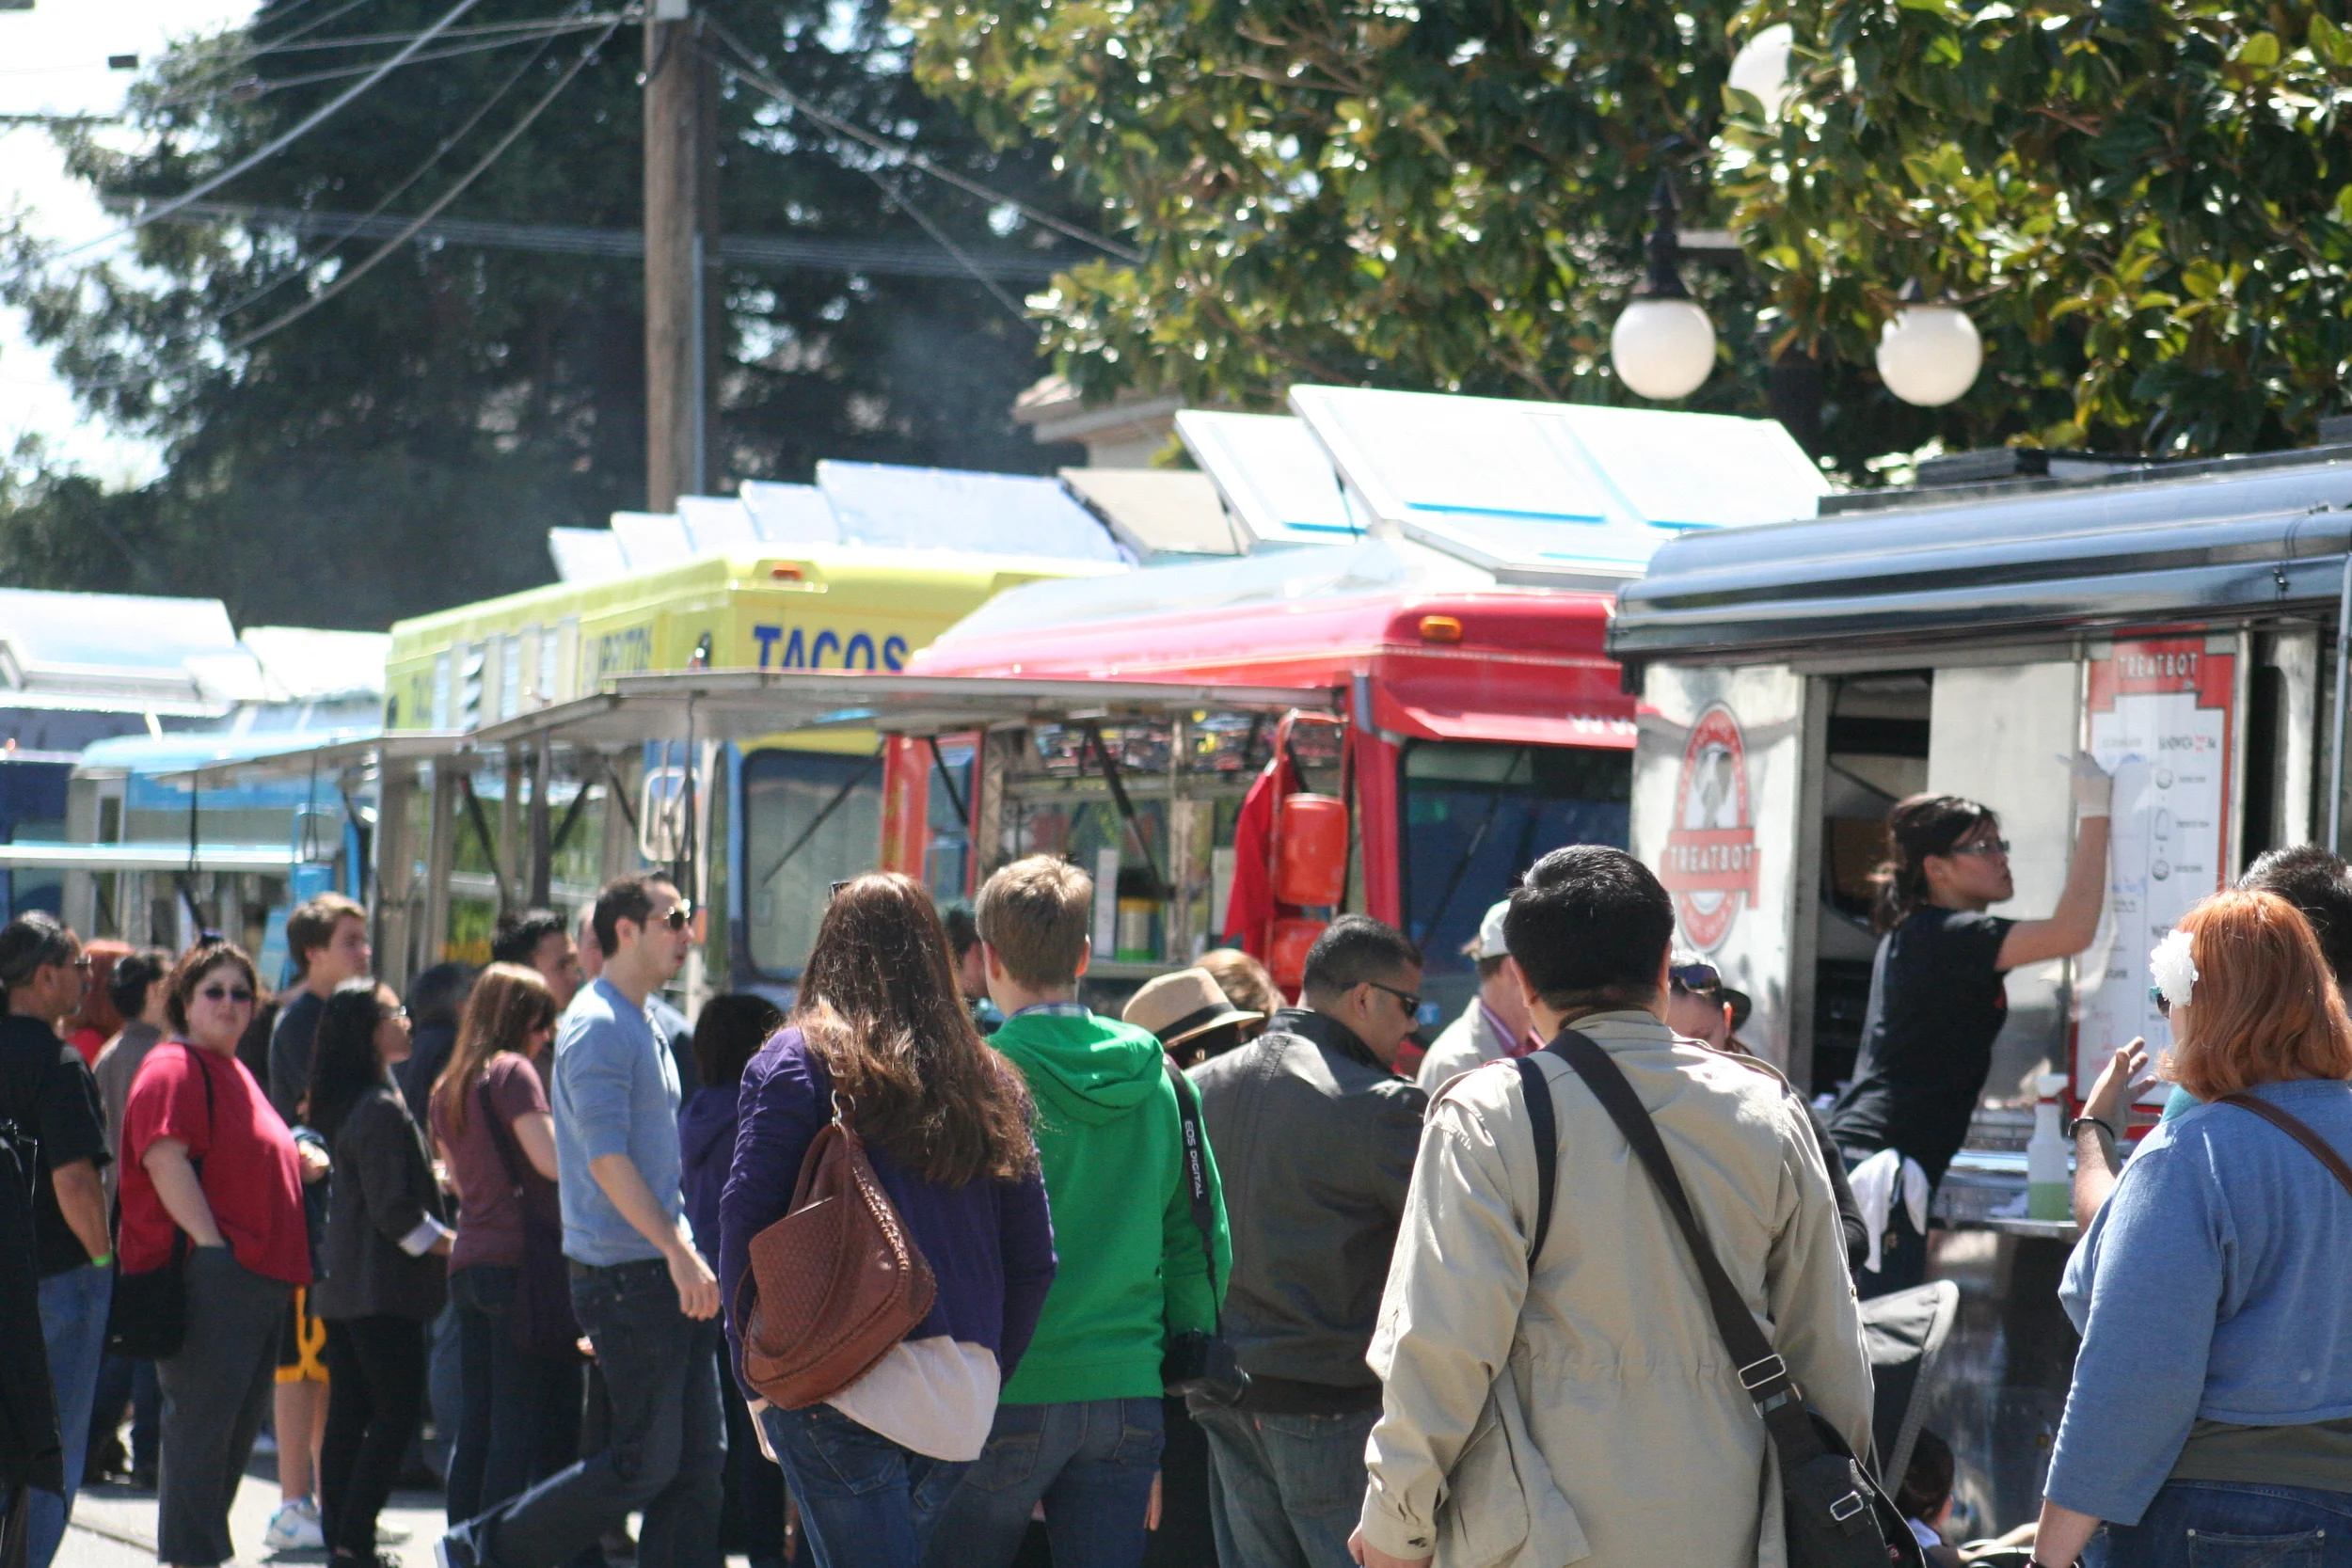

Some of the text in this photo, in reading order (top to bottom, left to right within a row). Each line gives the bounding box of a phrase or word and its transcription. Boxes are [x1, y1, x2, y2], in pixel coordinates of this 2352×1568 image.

[754, 626, 908, 672] TACOS
[2118, 651, 2199, 678] TREATBOT
[1669, 842, 1753, 873] TREATBOT
[1185, 1120, 1203, 1199] EOS DIGITAL
